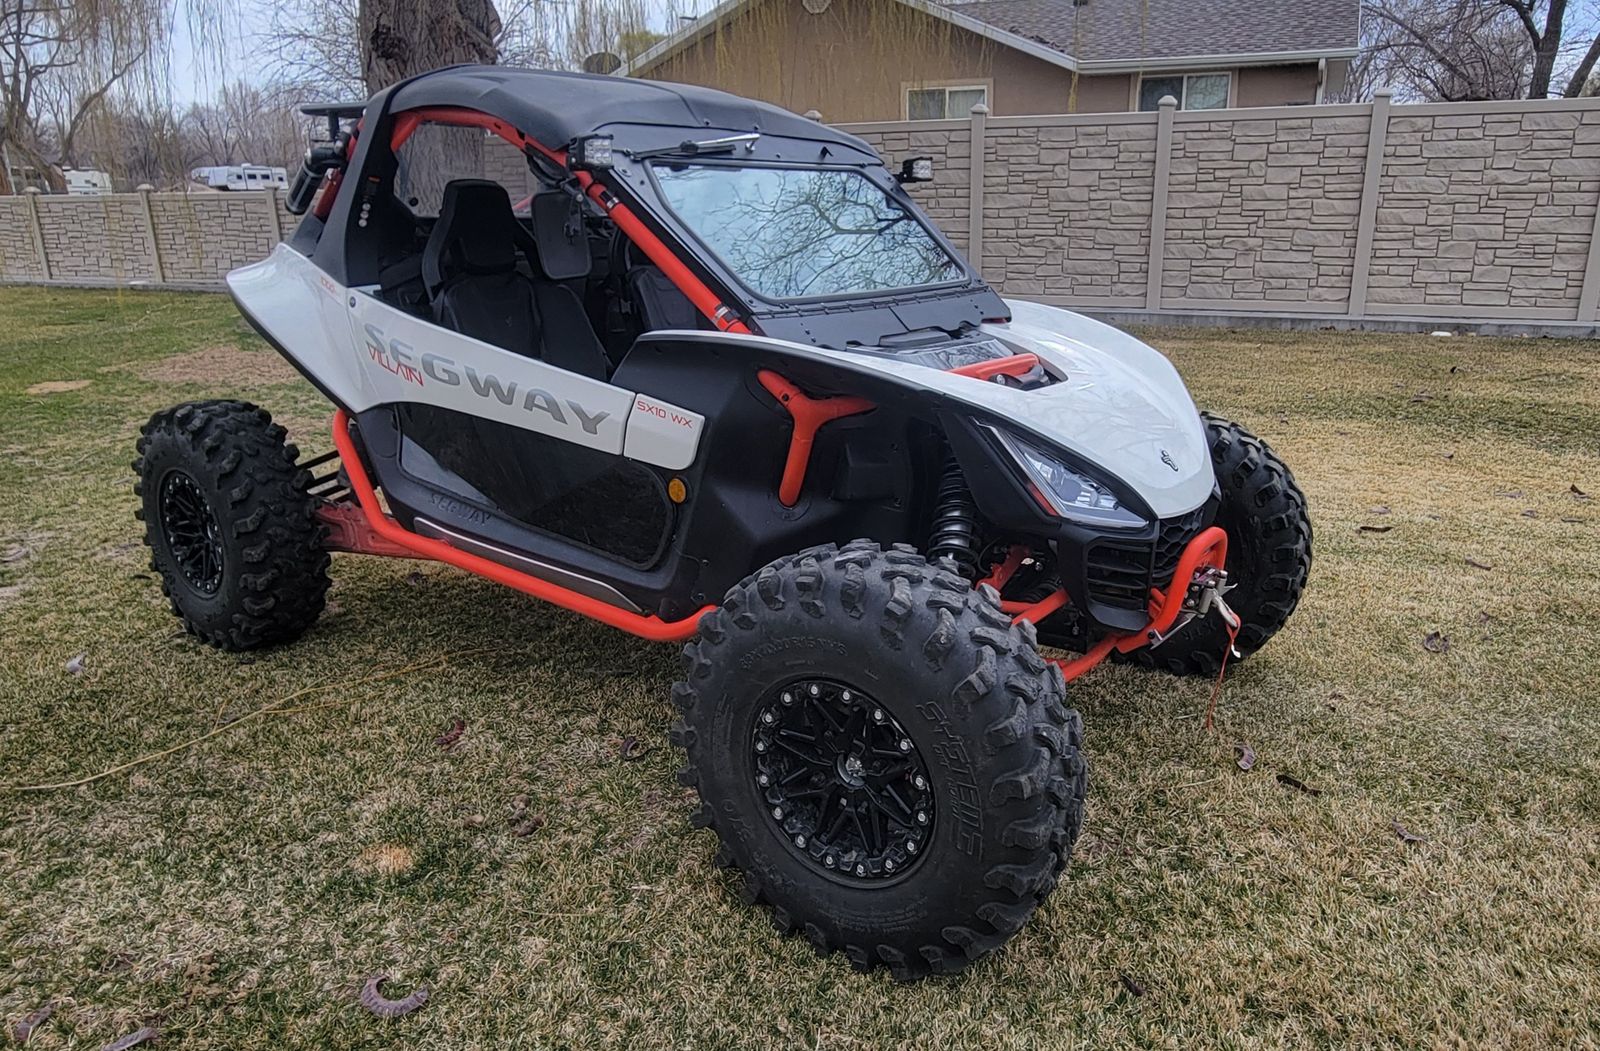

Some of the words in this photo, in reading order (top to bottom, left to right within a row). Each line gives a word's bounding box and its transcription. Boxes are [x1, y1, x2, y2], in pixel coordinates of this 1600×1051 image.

[364, 323, 610, 435] SEGWAY
[365, 340, 424, 387] VILLAIN
[637, 400, 667, 419] SX10
[670, 412, 693, 429] WX
